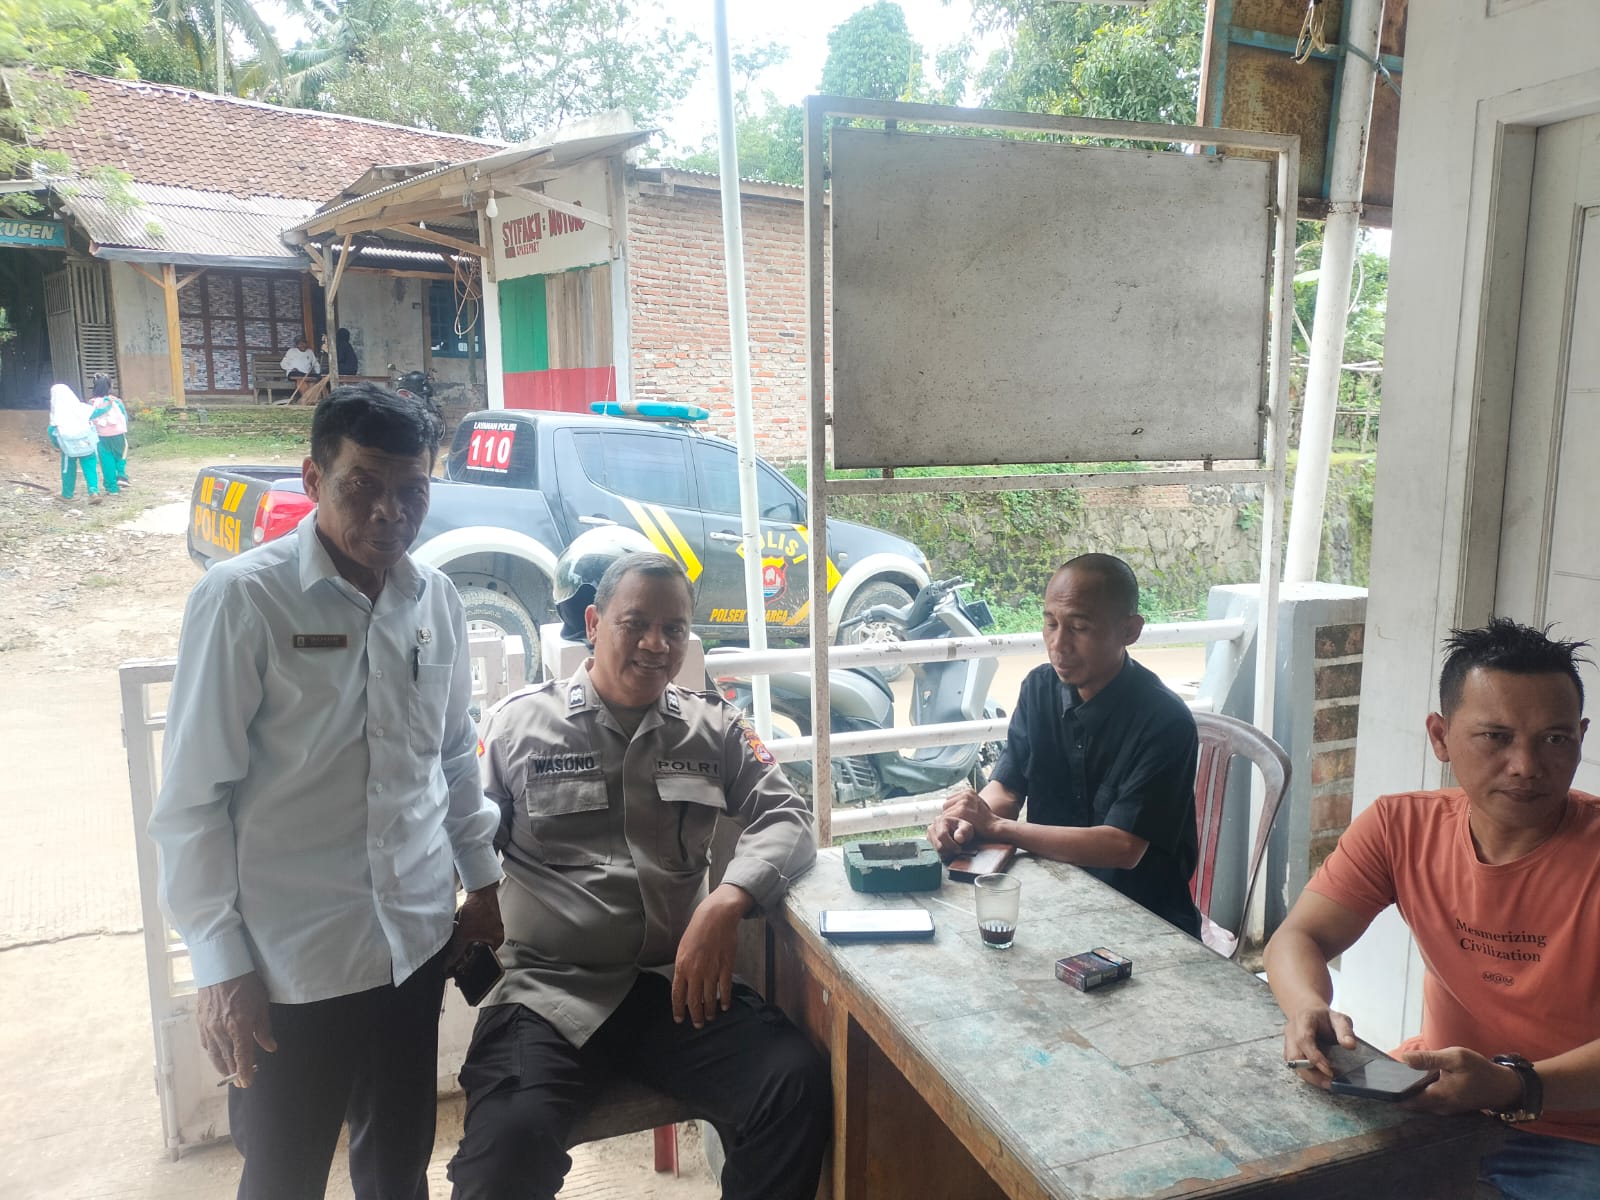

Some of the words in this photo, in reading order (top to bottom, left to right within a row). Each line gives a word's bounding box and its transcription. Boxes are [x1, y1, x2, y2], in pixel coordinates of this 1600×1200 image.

[471, 435, 510, 464] 110
[194, 504, 241, 554] POLISI
[735, 531, 807, 564] LISI
[709, 608, 746, 622] POLSEK
[534, 756, 595, 774] WASONO
[657, 760, 719, 775] POLRI
[1455, 918, 1547, 948] Mesmerizing
[1460, 937, 1541, 962] Civilization
